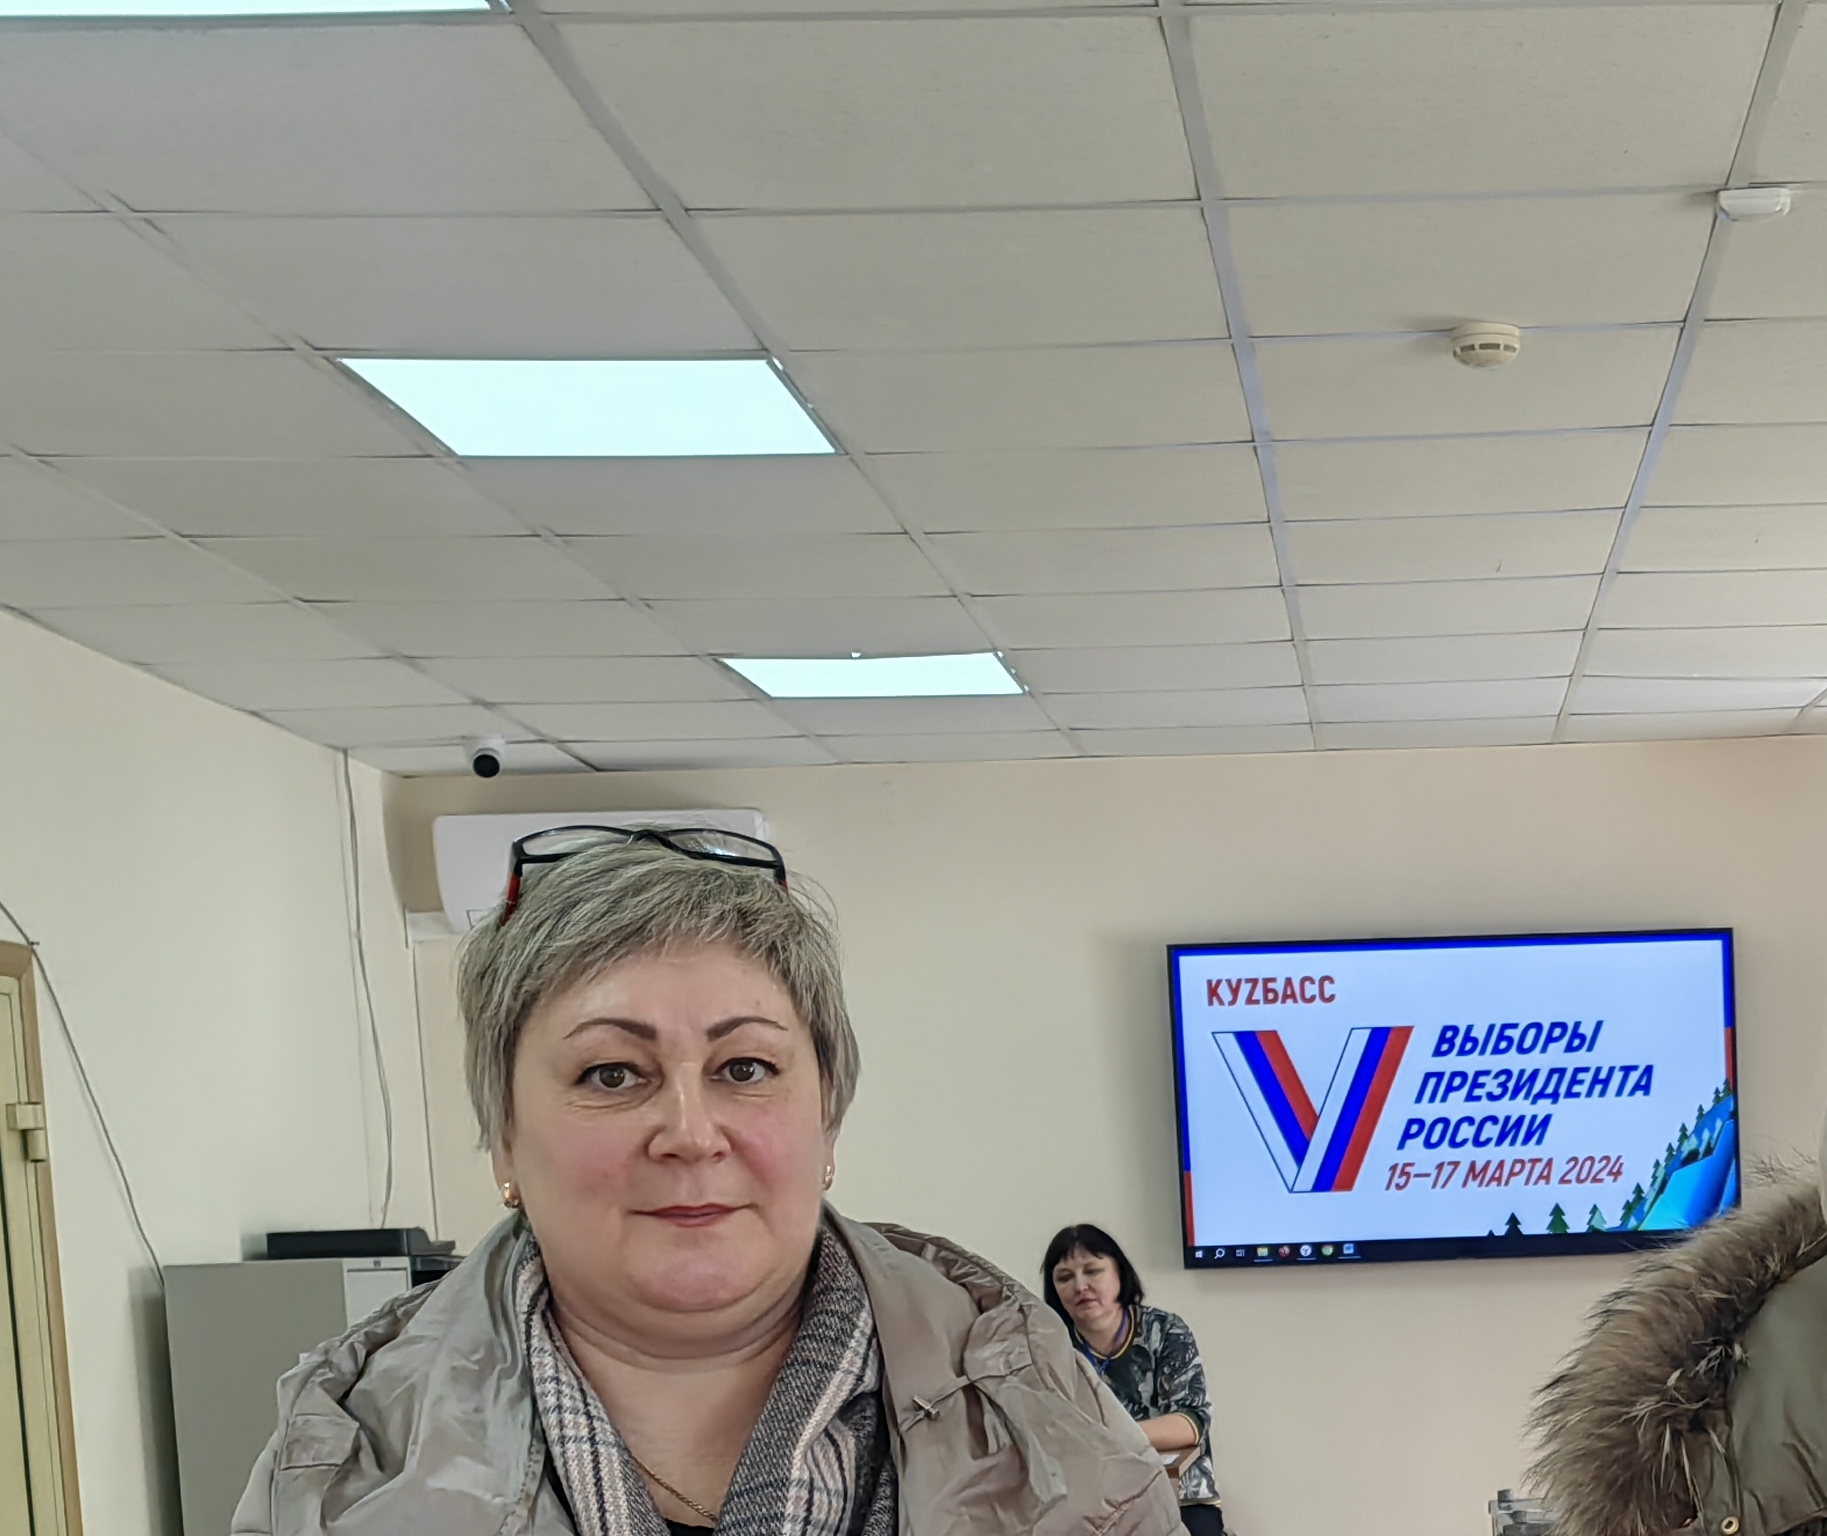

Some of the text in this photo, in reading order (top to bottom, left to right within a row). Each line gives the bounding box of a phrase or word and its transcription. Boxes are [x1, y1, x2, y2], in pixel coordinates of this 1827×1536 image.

[1431, 1020, 1604, 1057] ВЫБОРЫ
[1414, 1065, 1654, 1105] ПРЕЗИДЕНТА
[1397, 1113, 1552, 1150] РОССИИ
[1461, 1157, 1554, 1188] МАРТА
[1558, 1154, 1624, 1185] 2024
